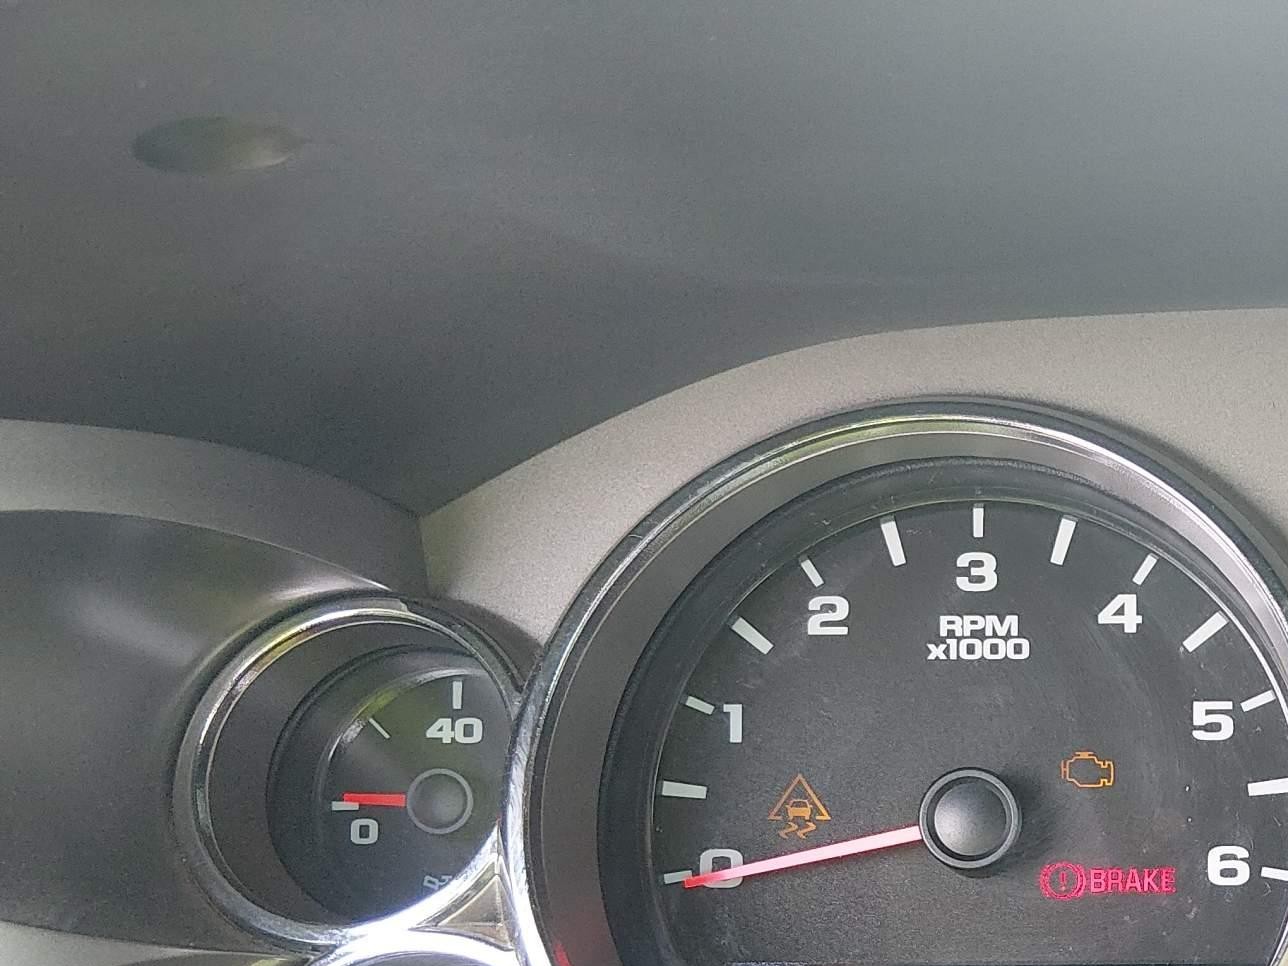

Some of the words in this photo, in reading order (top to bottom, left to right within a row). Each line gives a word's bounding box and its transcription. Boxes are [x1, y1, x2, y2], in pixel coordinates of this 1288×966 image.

[956, 551, 998, 593] 3
[807, 595, 850, 636] 2
[939, 614, 1018, 637] RPM
[1097, 593, 1142, 634] 4
[928, 638, 1029, 660] x1000
[425, 717, 484, 744] 40
[723, 702, 743, 744] 1
[1192, 700, 1235, 742] 5
[350, 818, 380, 846] 0
[699, 848, 744, 888] 0
[1089, 867, 1176, 894] BRAKE
[1207, 845, 1250, 886] 6
